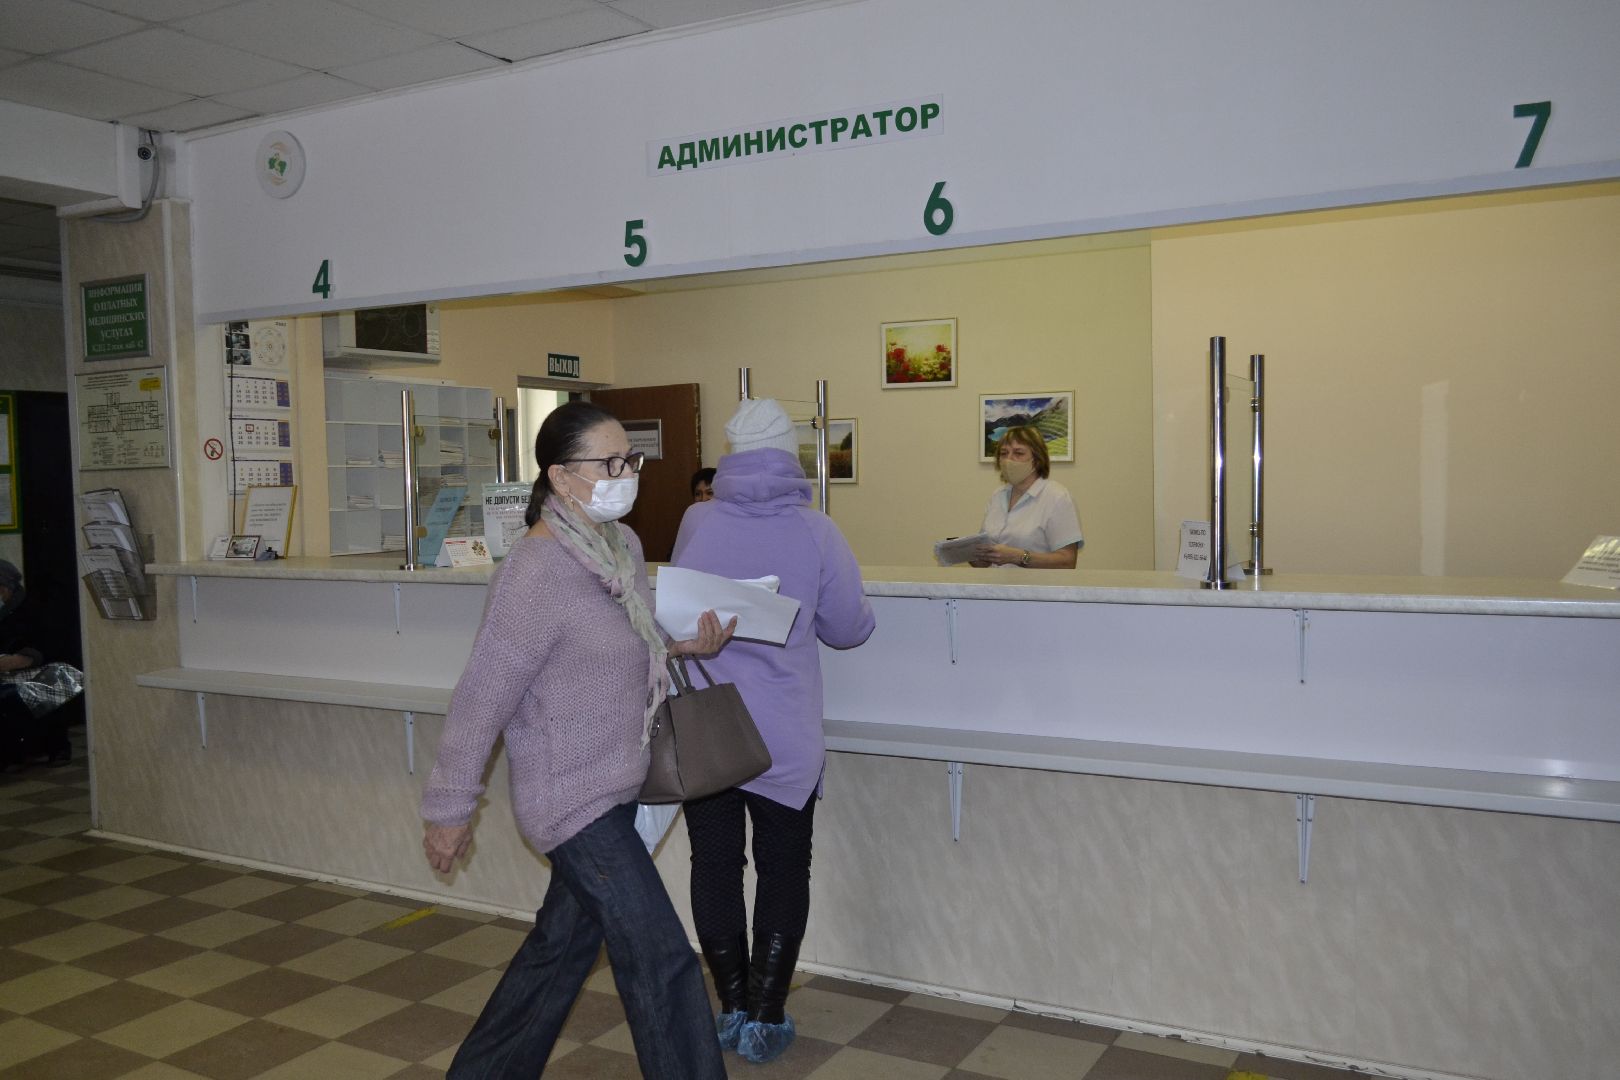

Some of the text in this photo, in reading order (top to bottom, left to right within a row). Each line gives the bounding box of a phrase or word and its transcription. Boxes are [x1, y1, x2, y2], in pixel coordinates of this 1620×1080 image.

[657, 102, 940, 171] АДМИНИСТРАТОР
[1513, 100, 1552, 169] 7
[923, 181, 954, 236] 6
[624, 219, 648, 267] 5
[312, 259, 331, 299] 4
[88, 311, 145, 327] МЕДИЦИНСКИХ
[101, 298, 138, 311] ПЛАТНЫХ
[100, 327, 134, 341] УСЛУГАХ
[549, 357, 579, 377] ВЫХОД
[485, 496, 492, 505] НЕ
[494, 495, 520, 505] ДОПУСТИ
